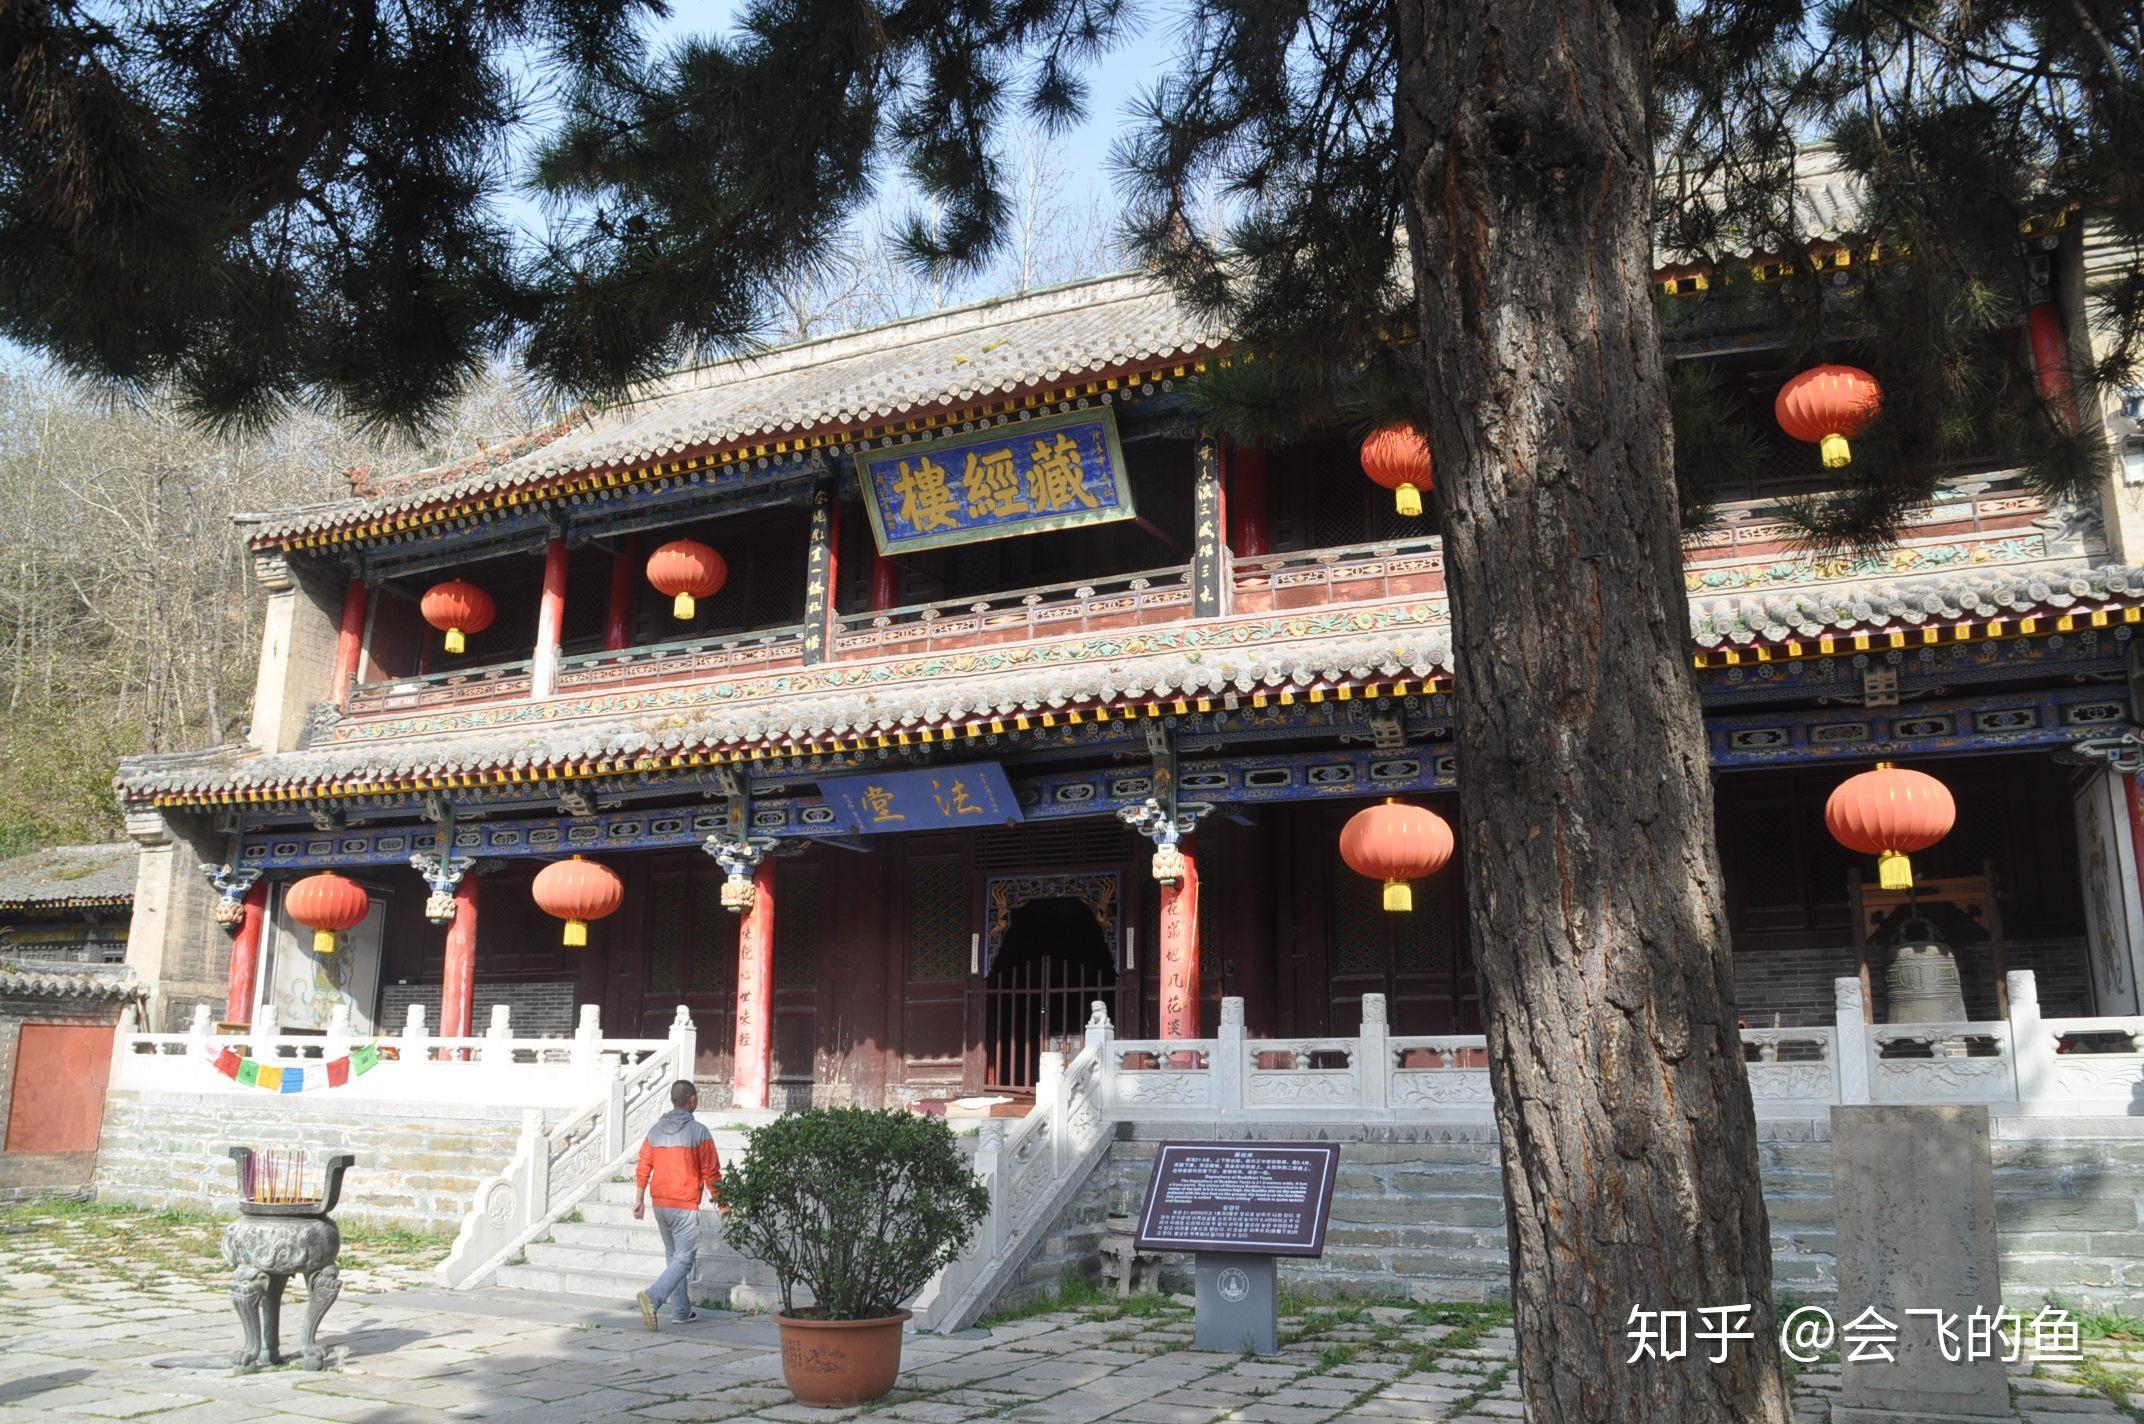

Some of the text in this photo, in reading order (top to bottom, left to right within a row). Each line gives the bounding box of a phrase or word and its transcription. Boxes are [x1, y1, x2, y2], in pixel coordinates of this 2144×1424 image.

[892, 434, 1100, 532] 藏經樓
[861, 778, 983, 824] 法堂
